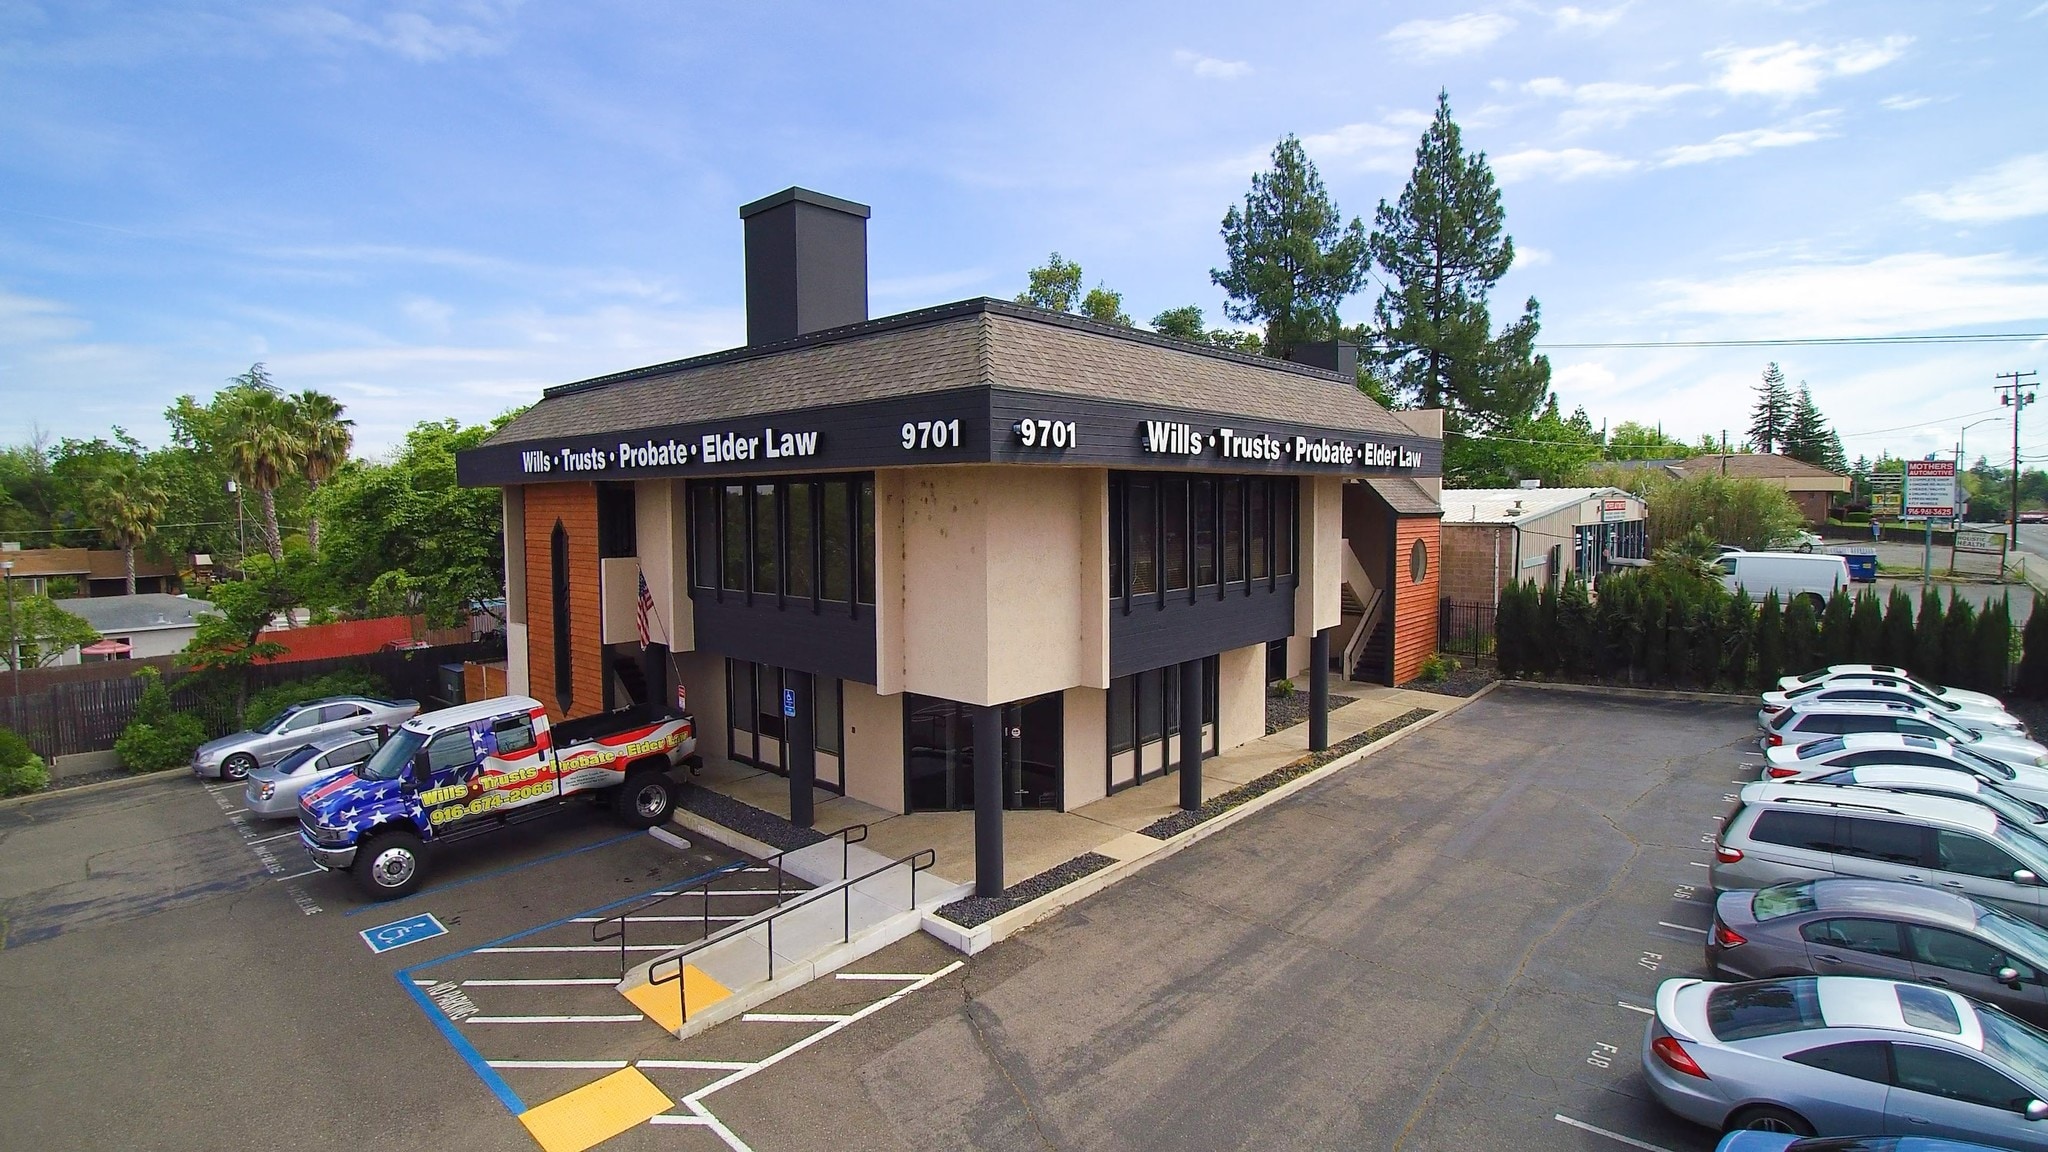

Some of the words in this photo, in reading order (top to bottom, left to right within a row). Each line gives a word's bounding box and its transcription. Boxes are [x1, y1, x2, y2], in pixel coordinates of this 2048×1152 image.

[902, 419, 960, 450] 9701
[1021, 418, 1077, 448] 9701
[1147, 420, 1202, 455] Wills
[1220, 428, 1280, 460] Trusts
[1295, 436, 1353, 464] Probate
[1364, 442, 1397, 467] Elder
[1399, 445, 1422, 468] Law
[522, 450, 551, 473] Wills
[561, 448, 606, 472] Trusts
[619, 440, 687, 468] Probate
[702, 432, 759, 463] Elder
[765, 428, 817, 458] Law
[1907, 508, 1952, 516] 916-961-3625
[420, 784, 469, 807] Wills
[478, 766, 538, 791] Trusts
[549, 751, 617, 773] Probate
[626, 738, 667, 757] Elder
[666, 731, 689, 748] Law
[430, 780, 554, 825] 916-674-2066
[1673, 884, 1695, 899] FJ6
[1638, 951, 1662, 971] FJ7
[426, 980, 458, 996] NO
[434, 990, 480, 1021] PARKING
[1586, 1041, 1618, 1069] FJ8
